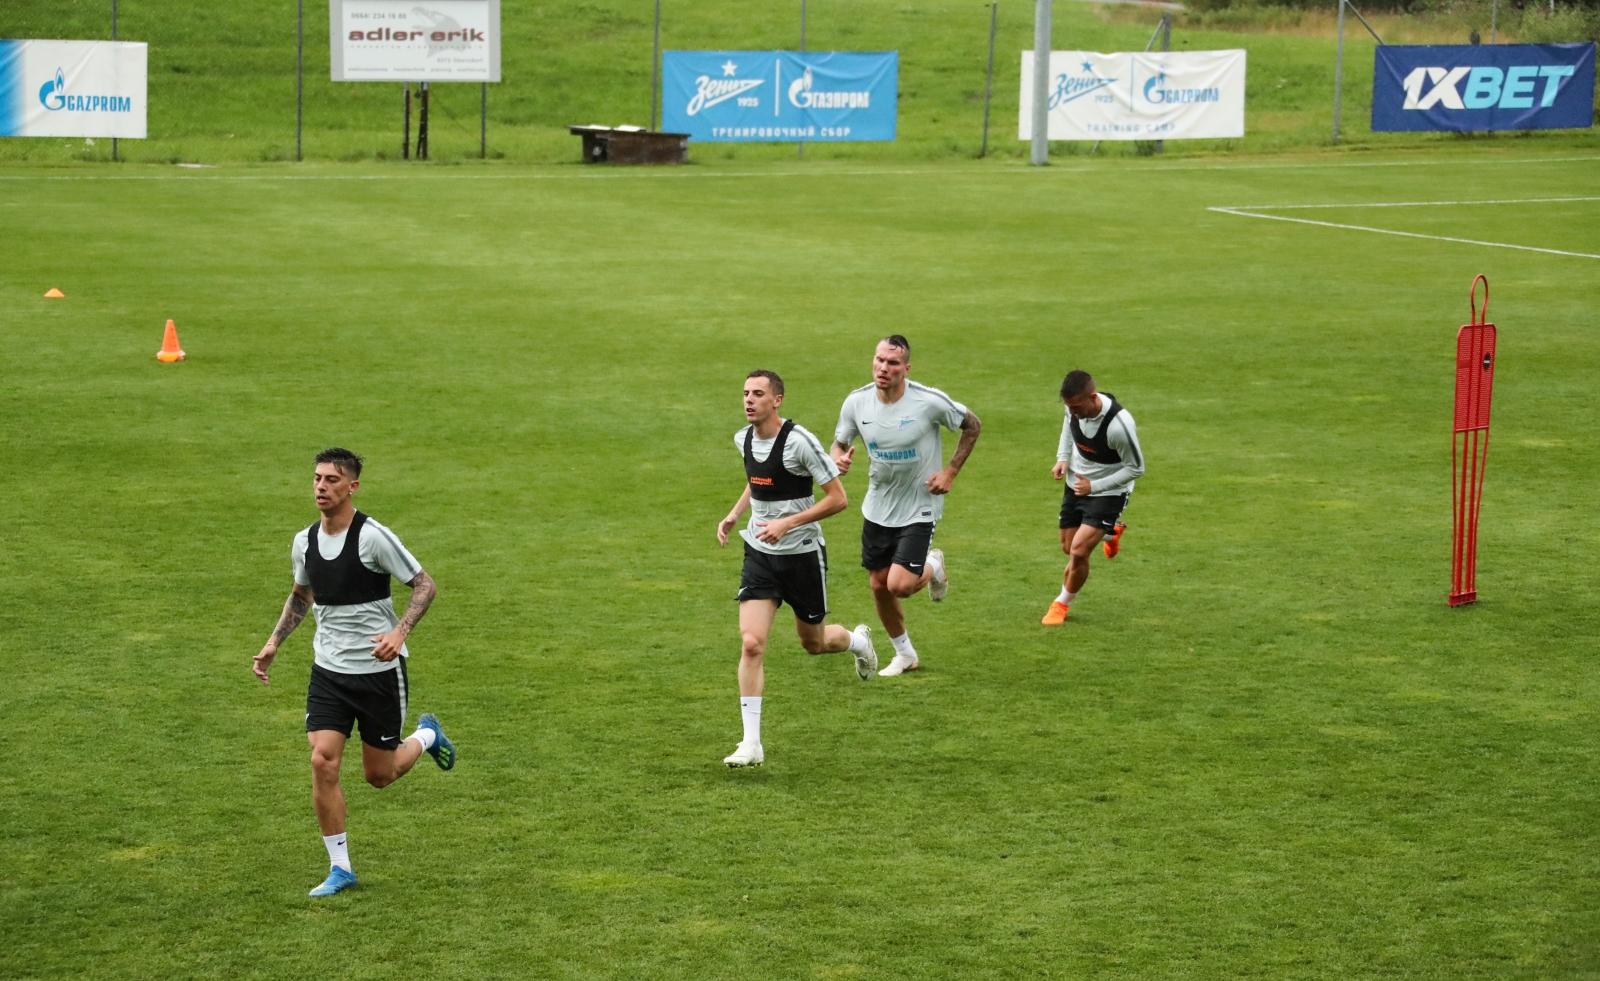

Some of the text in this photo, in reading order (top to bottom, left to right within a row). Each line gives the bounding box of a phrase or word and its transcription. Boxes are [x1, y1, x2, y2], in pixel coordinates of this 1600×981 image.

[348, 27, 485, 42] adler erik
[1402, 65, 1575, 110] 1XBET
[687, 75, 765, 116] Зенит
[737, 98, 759, 107] 1925
[812, 92, 870, 108] ГАЗПРОМ
[1094, 95, 1114, 103] 1925
[1166, 88, 1219, 103] GAZPROM
[67, 95, 131, 112] GAZPROM
[712, 127, 851, 137] ТРЕНИРОВОЧНЫЙ СБОР
[1087, 123, 1176, 132] TRAINING CAMP
